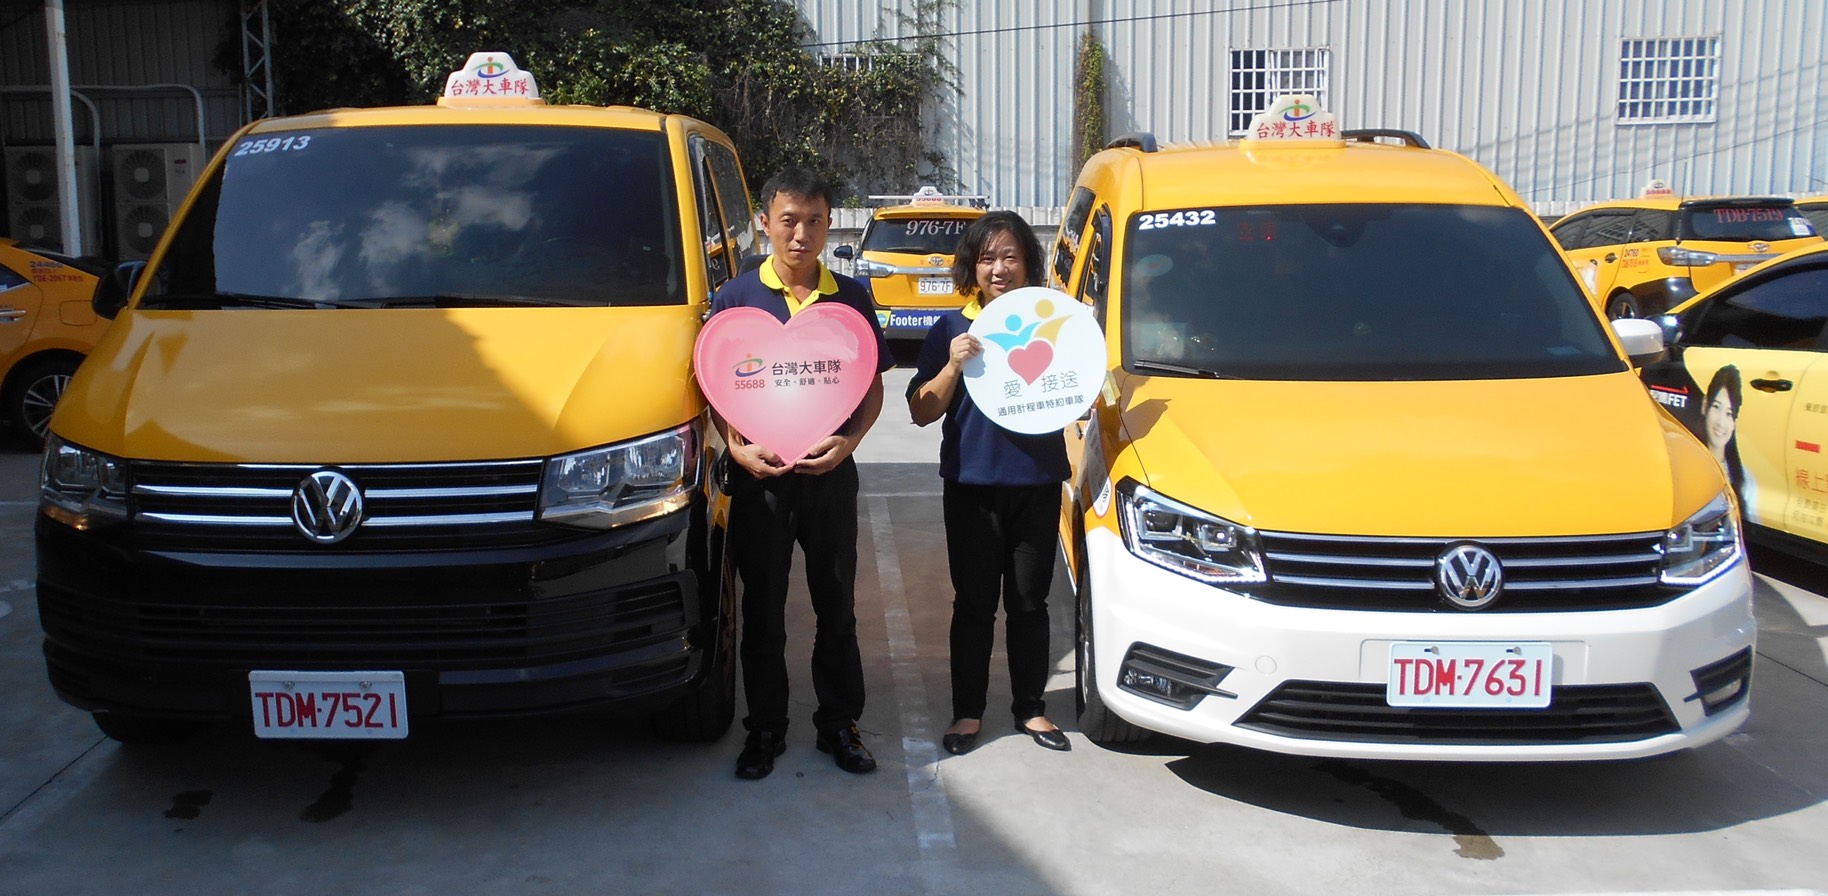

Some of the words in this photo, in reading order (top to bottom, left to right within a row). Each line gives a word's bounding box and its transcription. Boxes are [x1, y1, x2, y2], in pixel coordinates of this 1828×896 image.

[451, 78, 529, 97] 台灣大車隊
[1256, 120, 1336, 139] 台灣大車隊
[234, 135, 311, 157] 25913
[906, 220, 967, 236] 976-7F
[1138, 210, 1216, 230] 25432
[772, 359, 842, 376] 台灣大車隊
[734, 379, 766, 390] 55688
[1003, 379, 1022, 399] 愛
[1041, 370, 1079, 393] 接送
[997, 395, 1084, 417] 通用計程車特約車隊
